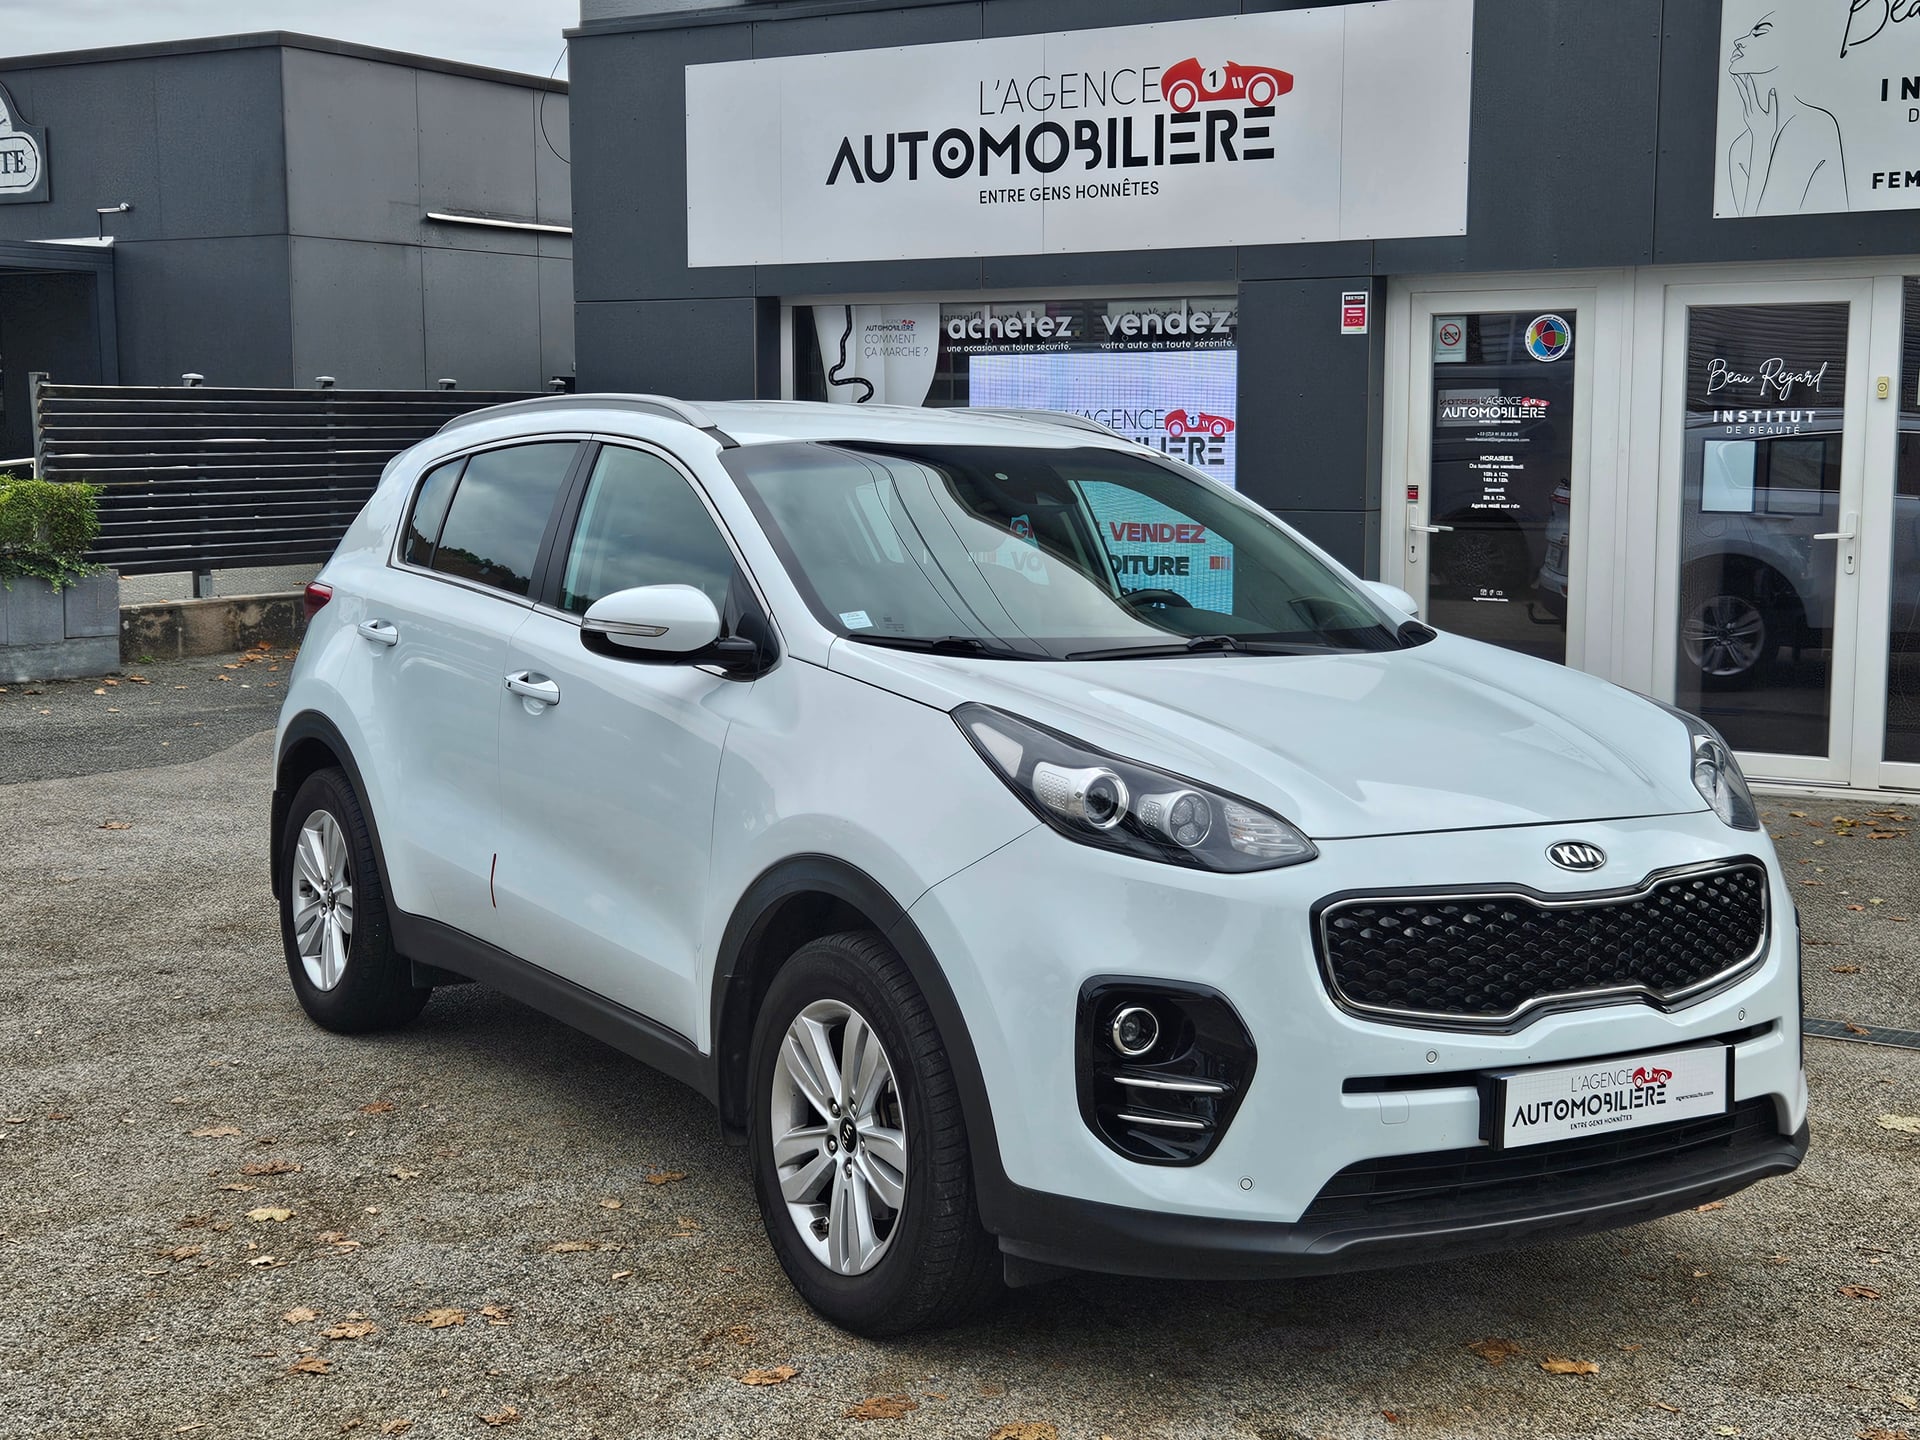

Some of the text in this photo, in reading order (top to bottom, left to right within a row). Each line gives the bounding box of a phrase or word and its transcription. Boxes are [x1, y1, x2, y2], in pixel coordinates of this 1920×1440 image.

[979, 66, 1161, 115] L'AGENCE
[979, 178, 1160, 204] ENTRE GENS HONNÊTES
[947, 304, 1073, 339] achetez
[1101, 299, 1231, 336] vendez
[864, 333, 917, 344] COMMENT
[946, 345, 962, 353] une
[963, 342, 998, 352] occasion
[1012, 343, 1034, 351] toute
[1100, 341, 1124, 349] votre
[1127, 340, 1149, 349] auto
[1151, 341, 1163, 349] en
[864, 346, 878, 359] ÇA
[880, 346, 921, 357] MARCHE
[1706, 357, 1828, 401] Beau Regard
[1479, 396, 1521, 406] L'AGENCE
[1713, 410, 1816, 423] INSTITUT
[1726, 423, 1801, 435] DE BEAUTÉ
[1110, 521, 1206, 544] VENDEZ
[1553, 844, 1603, 865] KIA
[1571, 1068, 1633, 1093] L'AGENCE
[1512, 1083, 1667, 1128] AUTOMOBILIERE
